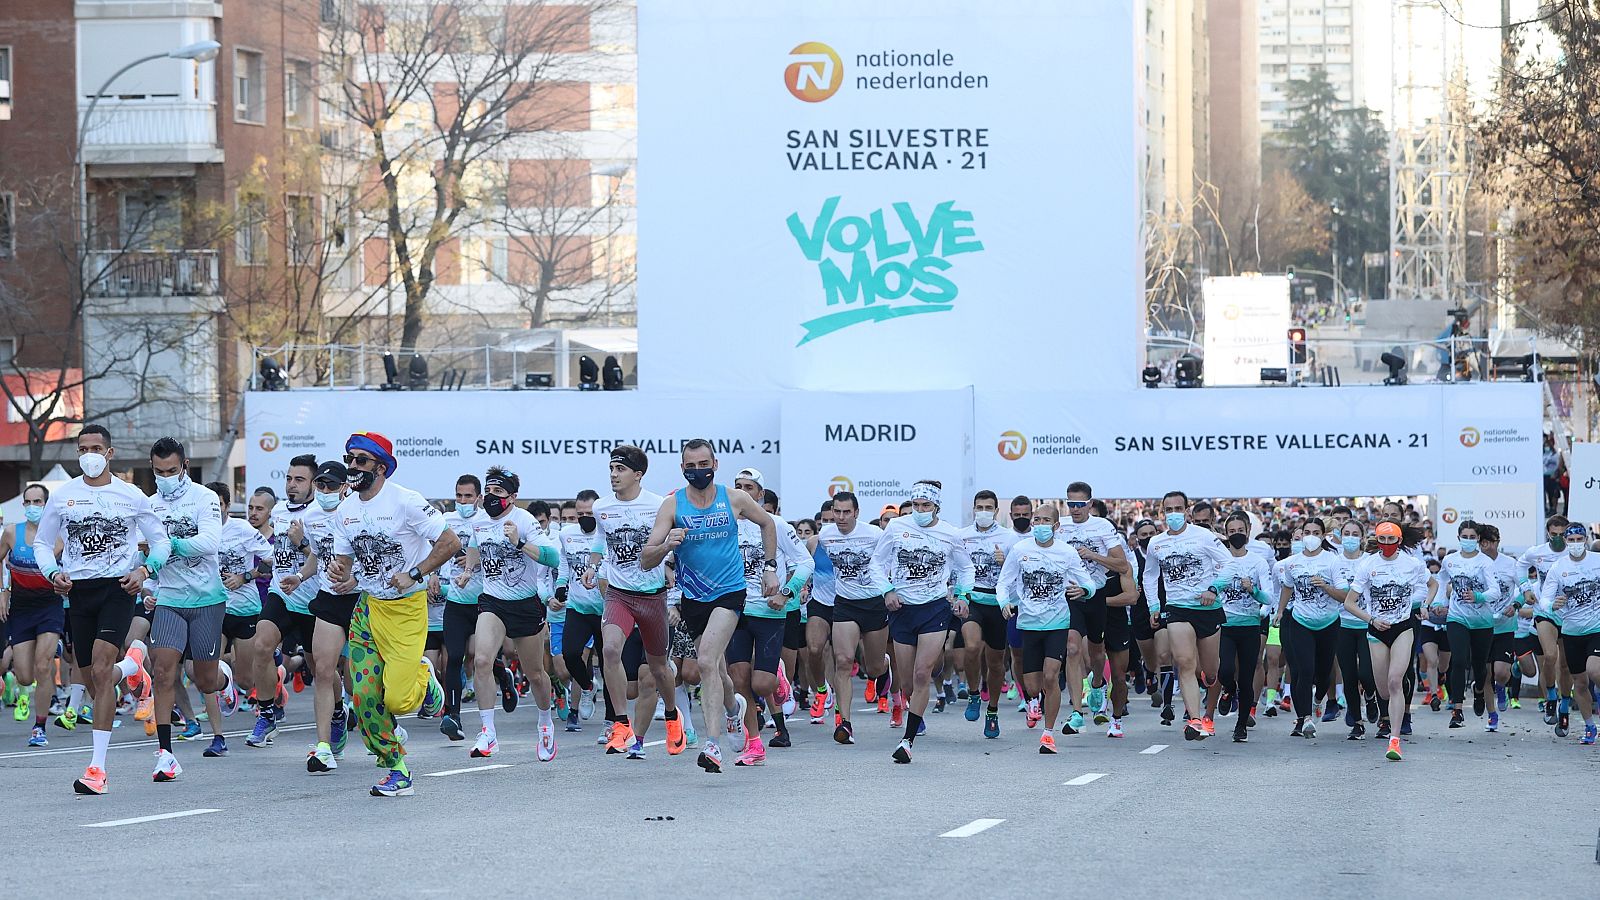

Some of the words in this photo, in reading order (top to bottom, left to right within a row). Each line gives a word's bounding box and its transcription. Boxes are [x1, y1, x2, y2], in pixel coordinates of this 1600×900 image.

[856, 49, 954, 67] nationale
[856, 71, 989, 90] nederlanden
[787, 129, 839, 149] SAN
[850, 128, 989, 148] SILVESTRE
[787, 151, 938, 171] VALLECANA
[961, 151, 988, 170] 21
[786, 195, 985, 262] VOLVE
[818, 250, 959, 307] MOS
[282, 433, 315, 441] nationale
[825, 424, 916, 442] MADRID
[1484, 428, 1518, 436] nationale
[396, 436, 443, 447] nationale
[1032, 433, 1081, 444] nationale
[1114, 436, 1154, 452] SAN
[1161, 434, 1268, 451] SILVESTRE
[1275, 432, 1391, 450] VALLECANA
[1408, 433, 1429, 448] 21
[1484, 435, 1530, 443] nederlanden
[282, 441, 326, 449] nederlanden
[476, 439, 514, 455] SAN
[761, 439, 780, 454] 21
[1032, 444, 1099, 455] nederlanden
[396, 447, 460, 458] nederlanden
[1471, 465, 1518, 476] OYSHO
[858, 479, 900, 488] nationale
[1484, 510, 1525, 519] OYSHO
[705, 516, 730, 528] ULSA
[685, 531, 729, 541] ATLETISMO
